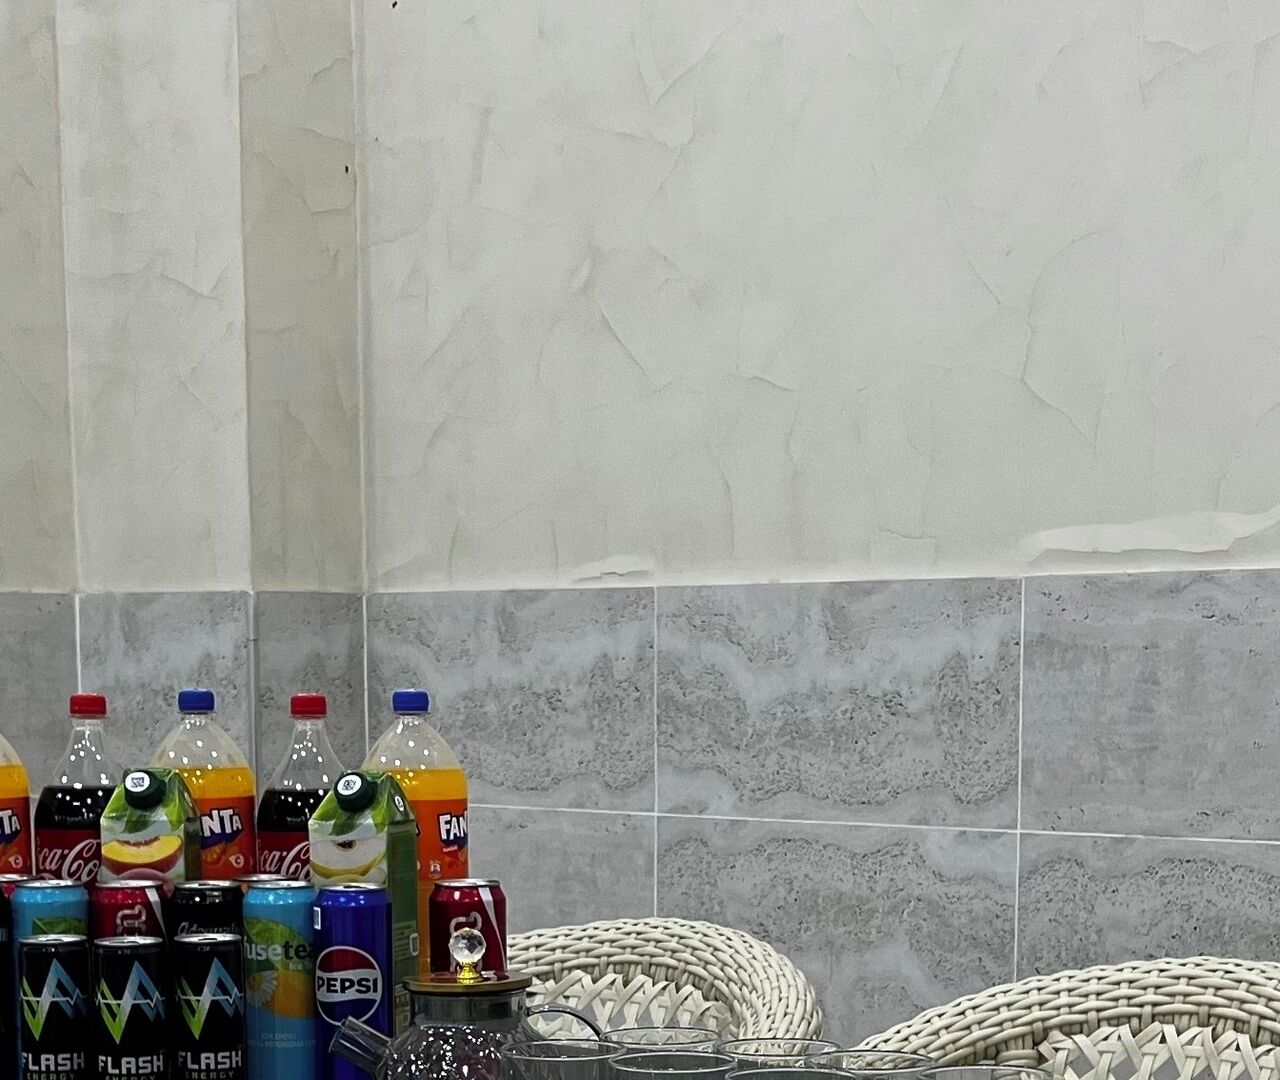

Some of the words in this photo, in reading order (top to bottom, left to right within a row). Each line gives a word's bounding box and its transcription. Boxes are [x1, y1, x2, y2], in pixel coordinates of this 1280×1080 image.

[200, 808, 242, 837] NTA
[439, 810, 467, 840] FAN
[37, 839, 101, 882] ca-Co
[260, 841, 310, 881] ca-Co
[317, 976, 378, 994] PEPSI
[22, 1052, 85, 1071] FLASH
[98, 1054, 164, 1075] FLASH
[178, 1050, 242, 1070] FLASH
